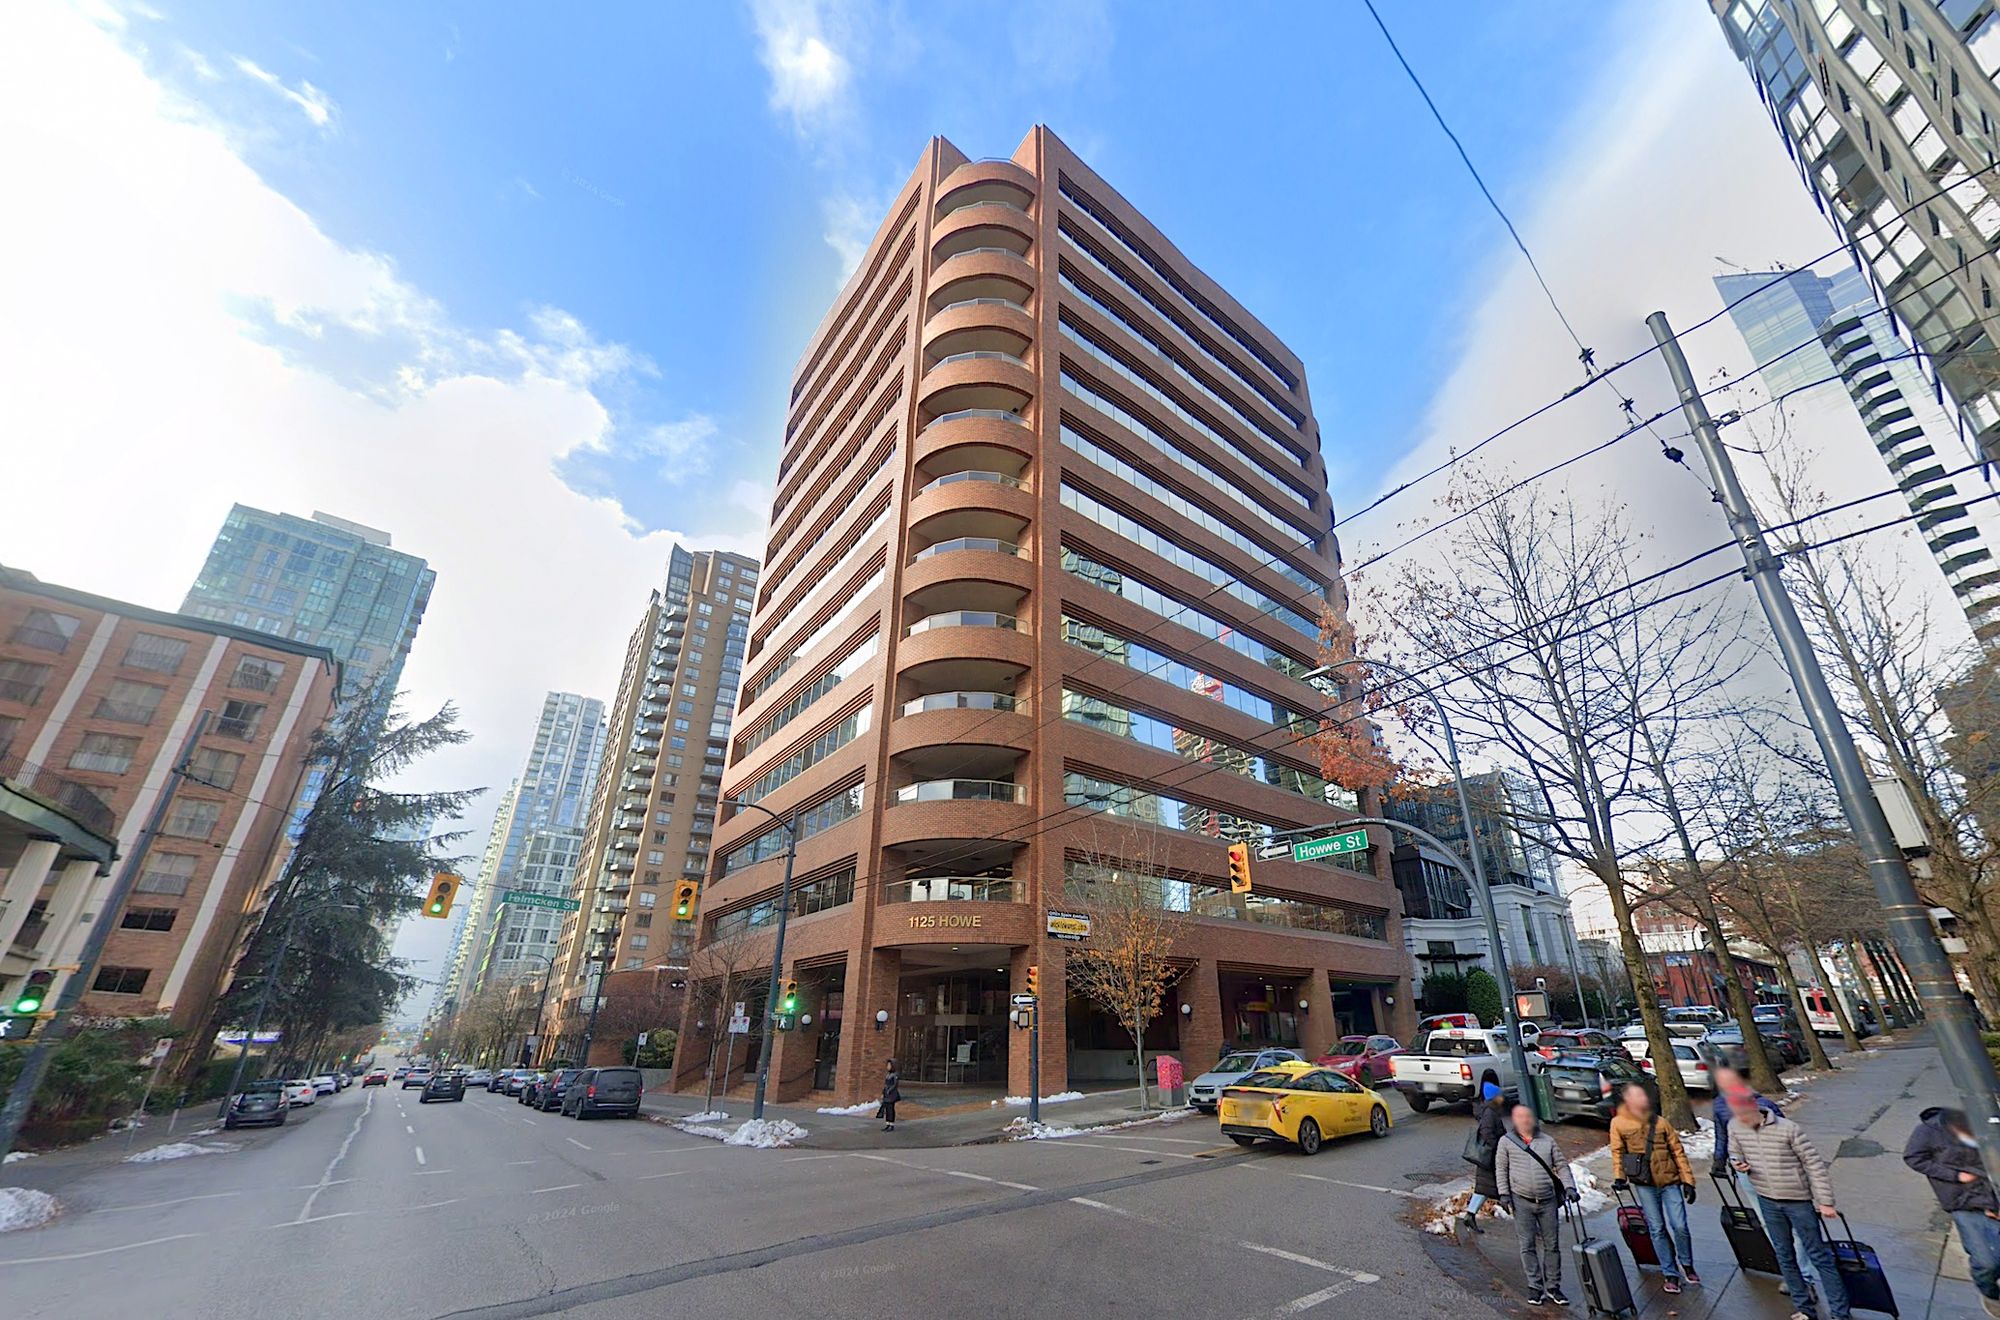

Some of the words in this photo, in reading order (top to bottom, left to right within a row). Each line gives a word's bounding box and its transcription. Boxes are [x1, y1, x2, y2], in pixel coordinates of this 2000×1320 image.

[1299, 841, 1341, 858] Howwe
[1346, 835, 1362, 848] St
[563, 901, 575, 910] St
[909, 916, 935, 928] 1125
[939, 915, 982, 928] HOWE
